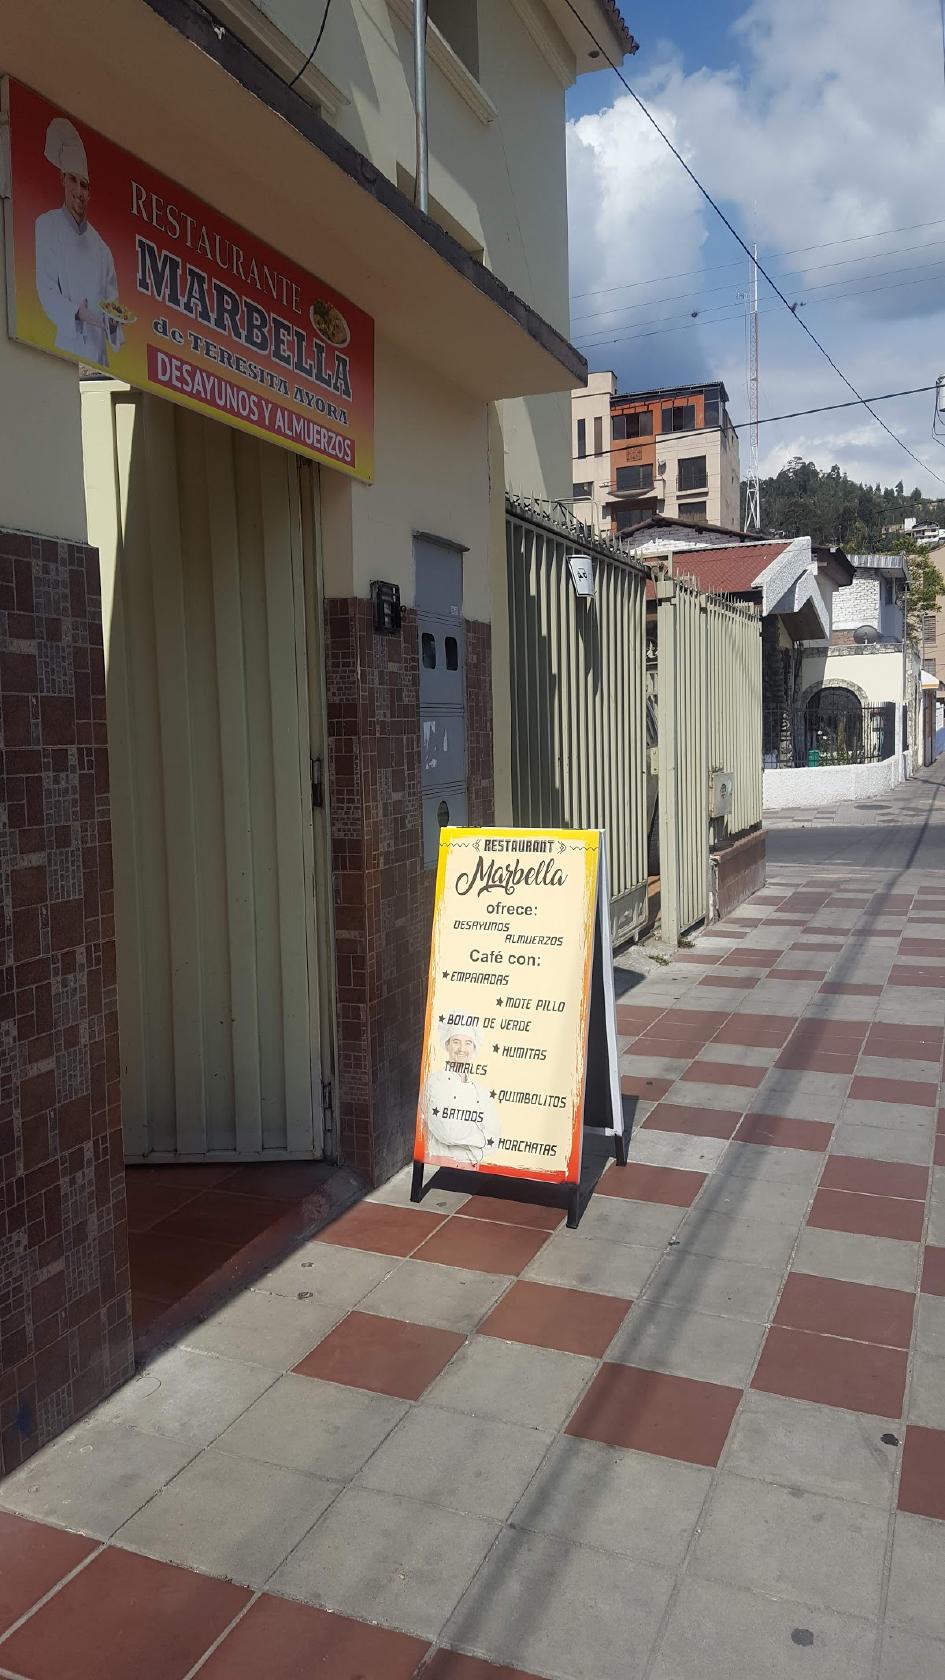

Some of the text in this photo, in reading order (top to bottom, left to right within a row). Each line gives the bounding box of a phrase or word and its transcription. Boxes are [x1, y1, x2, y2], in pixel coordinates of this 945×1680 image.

[130, 179, 302, 315] RESTAURANTE
[135, 234, 353, 401] MARBELLA
[153, 316, 349, 425] de TERESITA AYORA
[157, 351, 352, 462] DESAYUNOS Y ALMUERZOS
[484, 839, 555, 853] RESTAURANT
[455, 855, 568, 898] Marbella
[486, 901, 538, 916] ofrece:
[453, 920, 510, 932] DESAYUNOS
[504, 934, 564, 946] ALMUERZOS
[469, 949, 541, 966] Café con:
[450, 971, 510, 986] EMPANADAS
[505, 997, 566, 1013] MOTE PILLO
[446, 1014, 532, 1032] BOLON DE VERDE
[502, 1045, 547, 1061] HUMITAS
[444, 1060, 488, 1076] TAMALES
[498, 1089, 567, 1109] QUIMBOLITOS
[441, 1107, 484, 1123] BATIDOS
[498, 1137, 557, 1157] HORCHATAS
